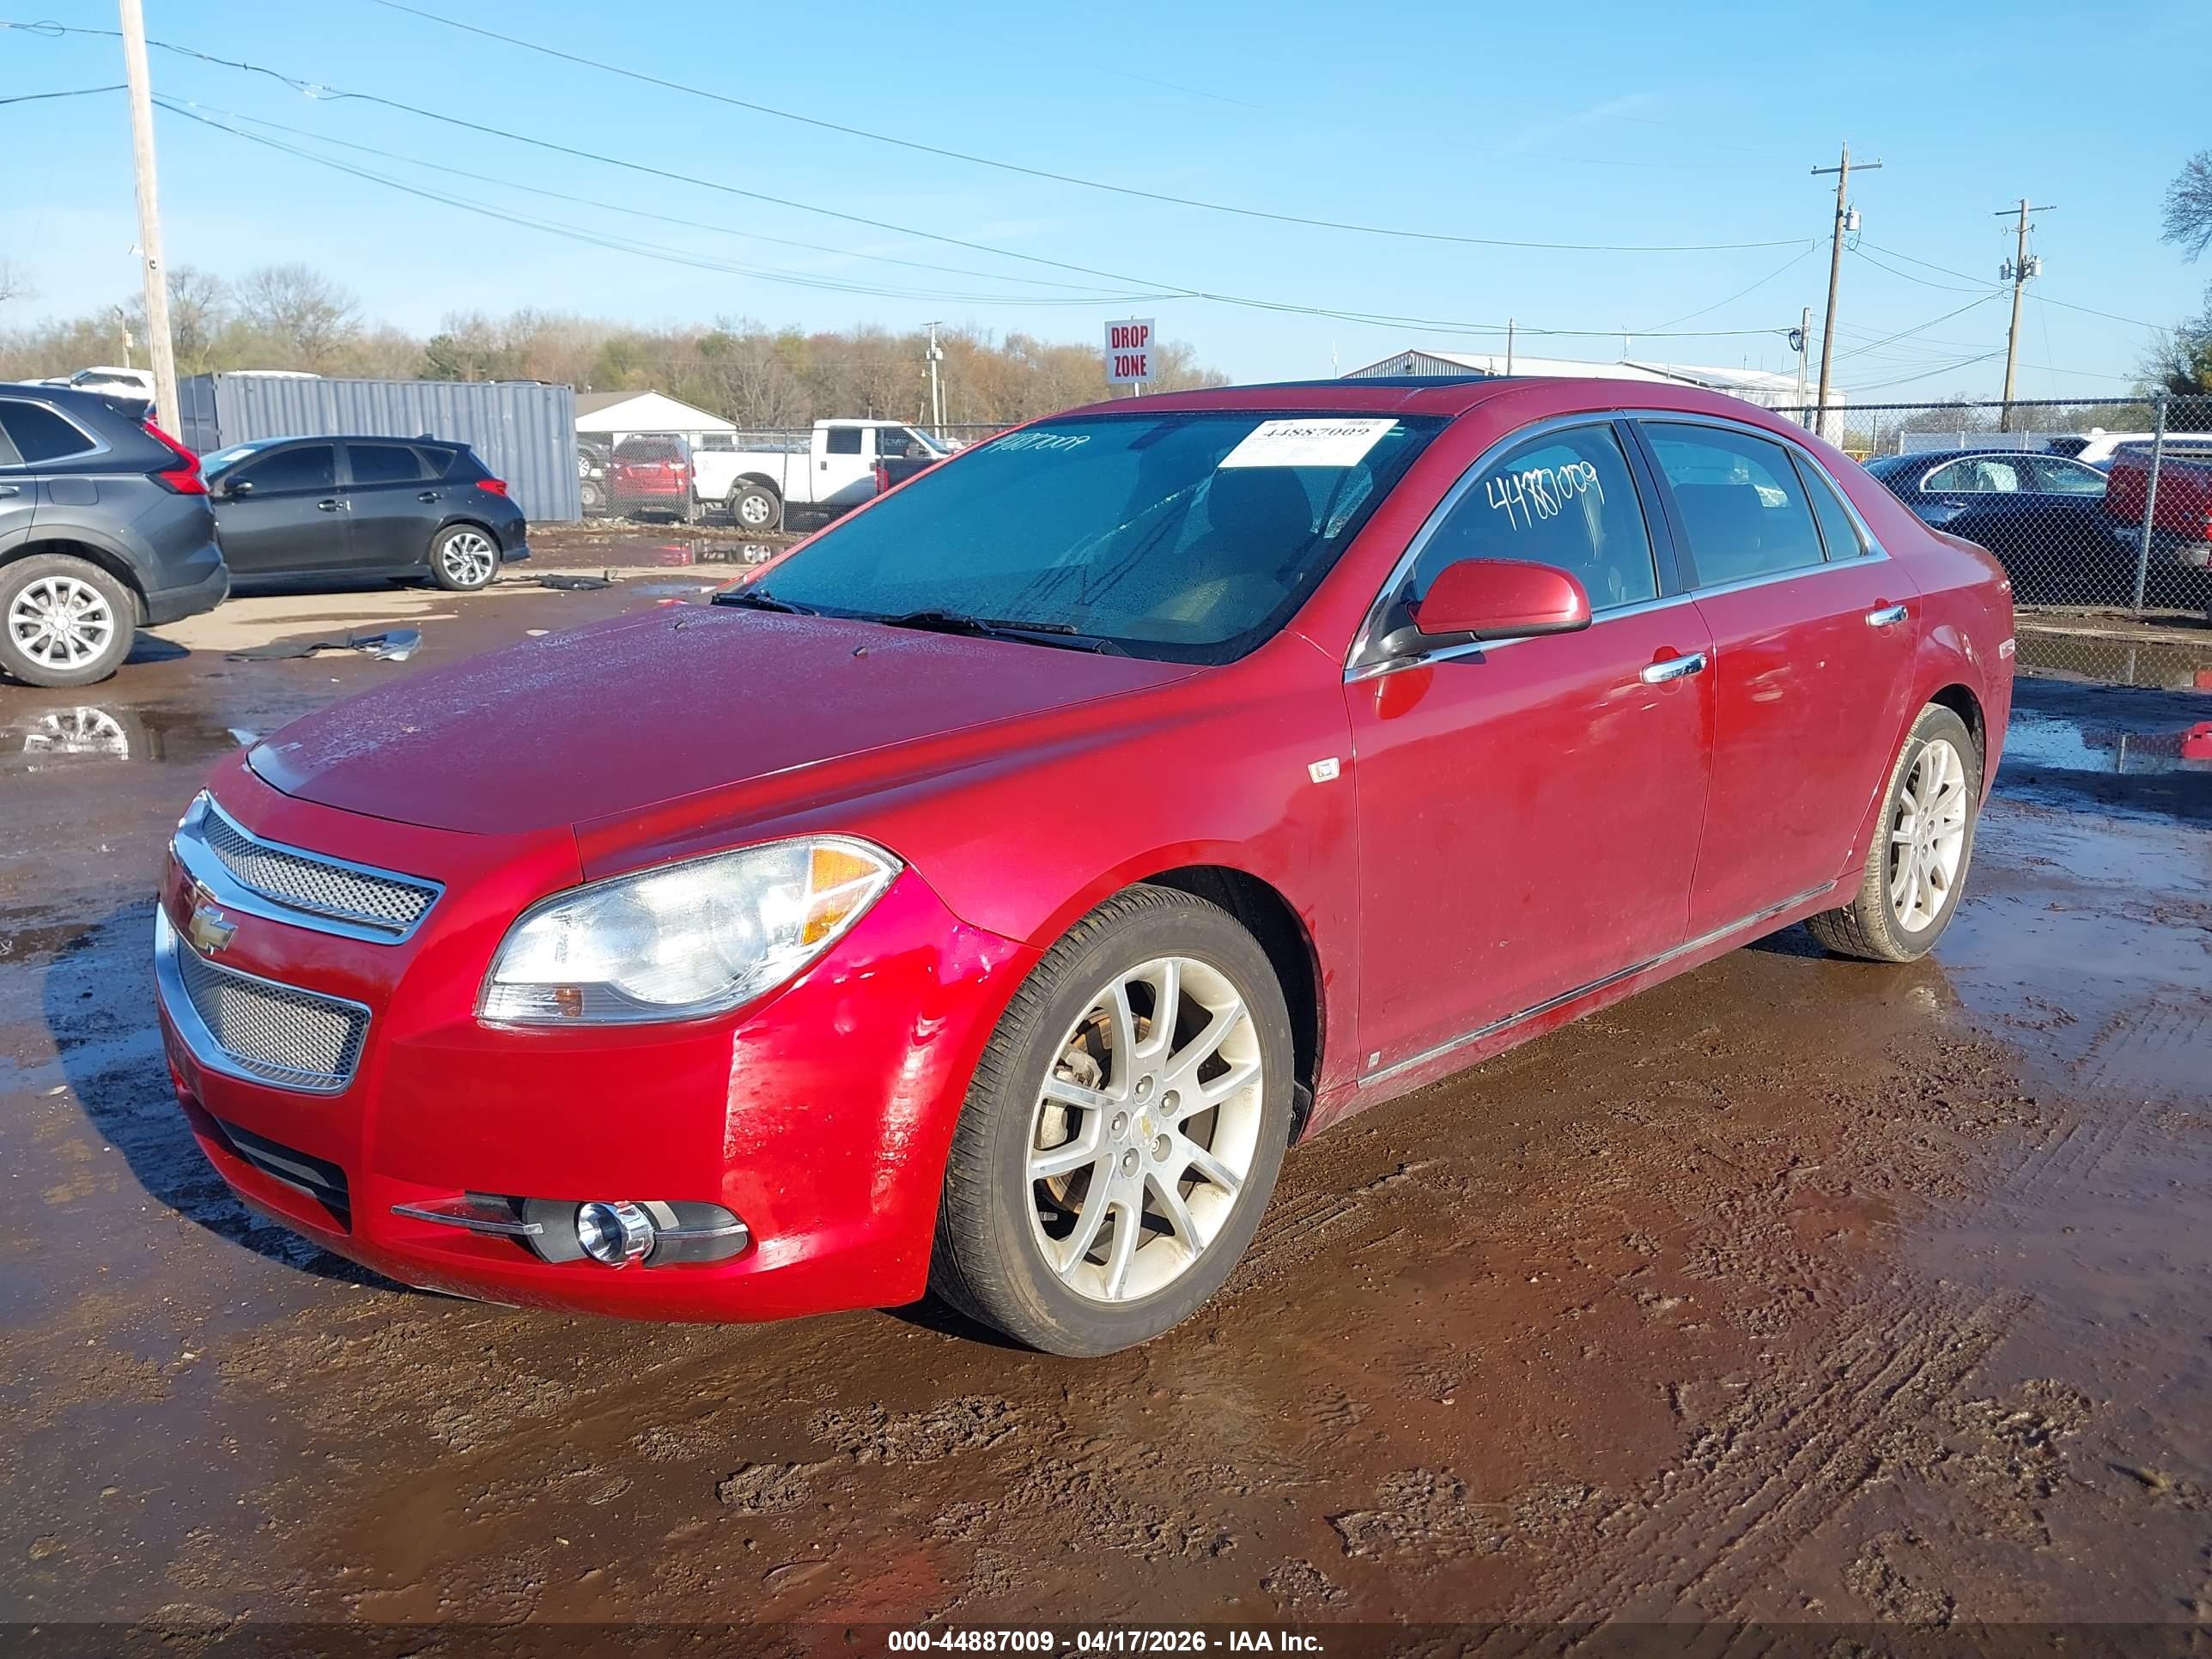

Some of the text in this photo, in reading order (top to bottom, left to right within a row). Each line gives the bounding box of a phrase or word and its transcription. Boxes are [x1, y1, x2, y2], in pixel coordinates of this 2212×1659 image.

[1111, 325, 1148, 349] DROP
[1115, 355, 1147, 377] ZONE
[1263, 427, 1370, 438] 44887009
[1486, 460, 1605, 532] 44887009
